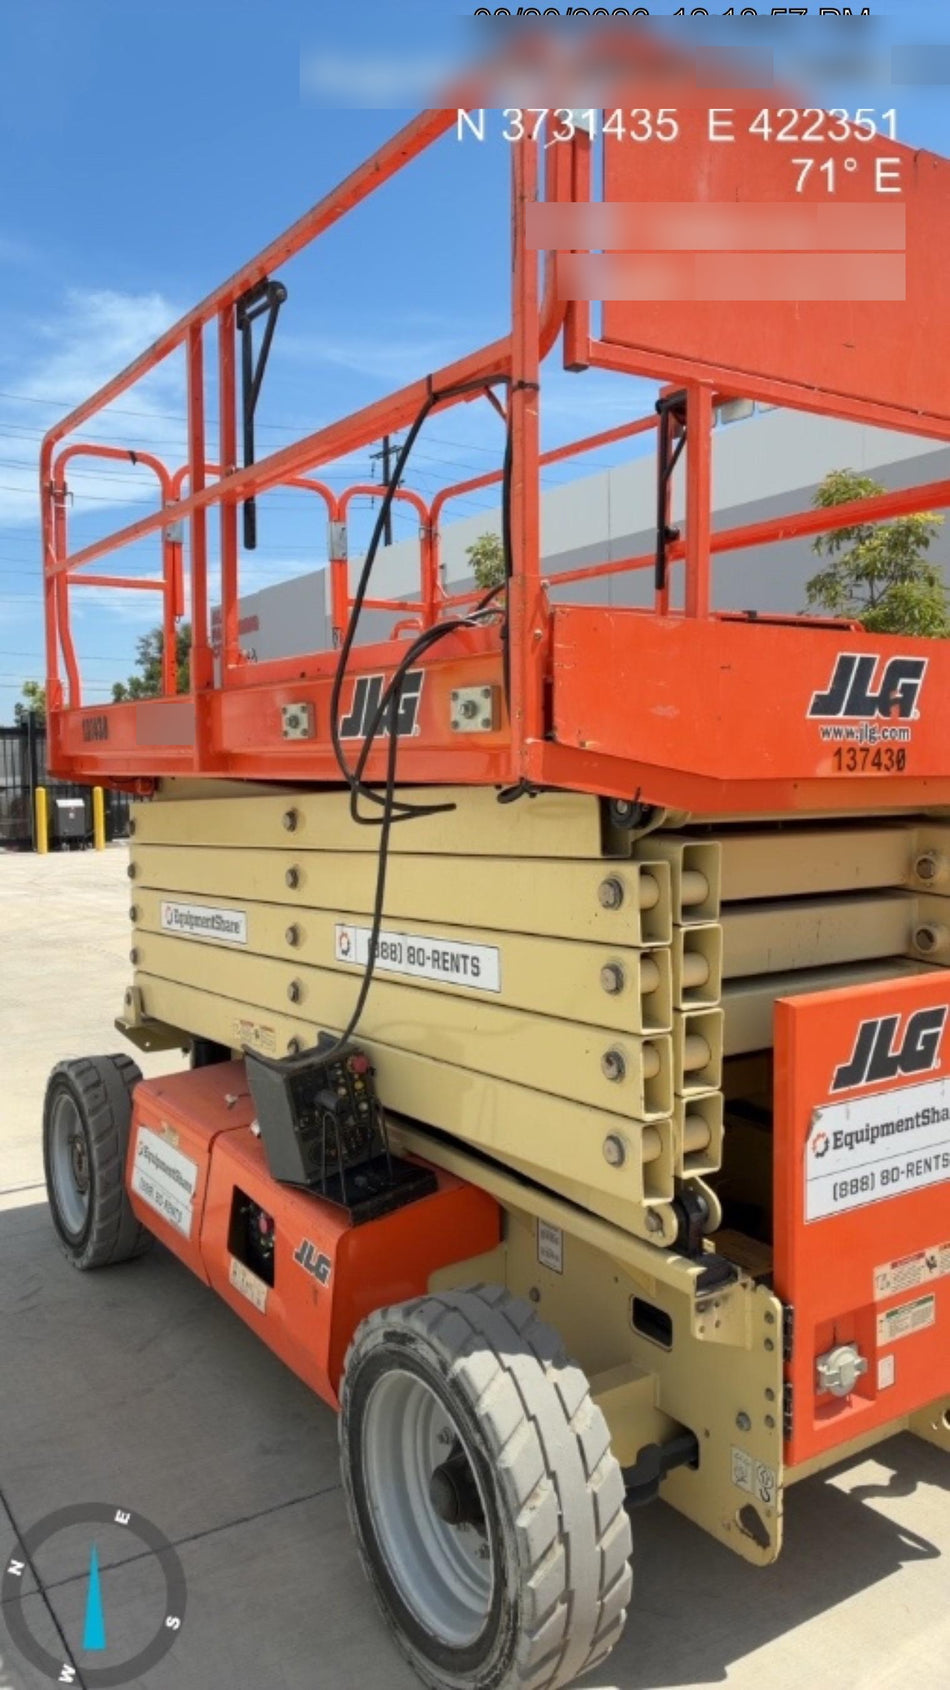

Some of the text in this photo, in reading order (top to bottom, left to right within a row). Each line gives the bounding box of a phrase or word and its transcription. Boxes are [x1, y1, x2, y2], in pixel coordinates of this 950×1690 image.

[339, 669, 424, 740] JLG
[806, 653, 929, 720] JLG
[820, 722, 911, 744] www.jlg.com
[833, 747, 906, 772] 137430
[406, 945, 481, 977] 80-RENTS
[829, 1006, 948, 1093] JLG
[832, 1107, 950, 1150] EquipmentSha
[832, 1152, 950, 1202] (888) 80-RENTS
[294, 1238, 331, 1288] JLG
